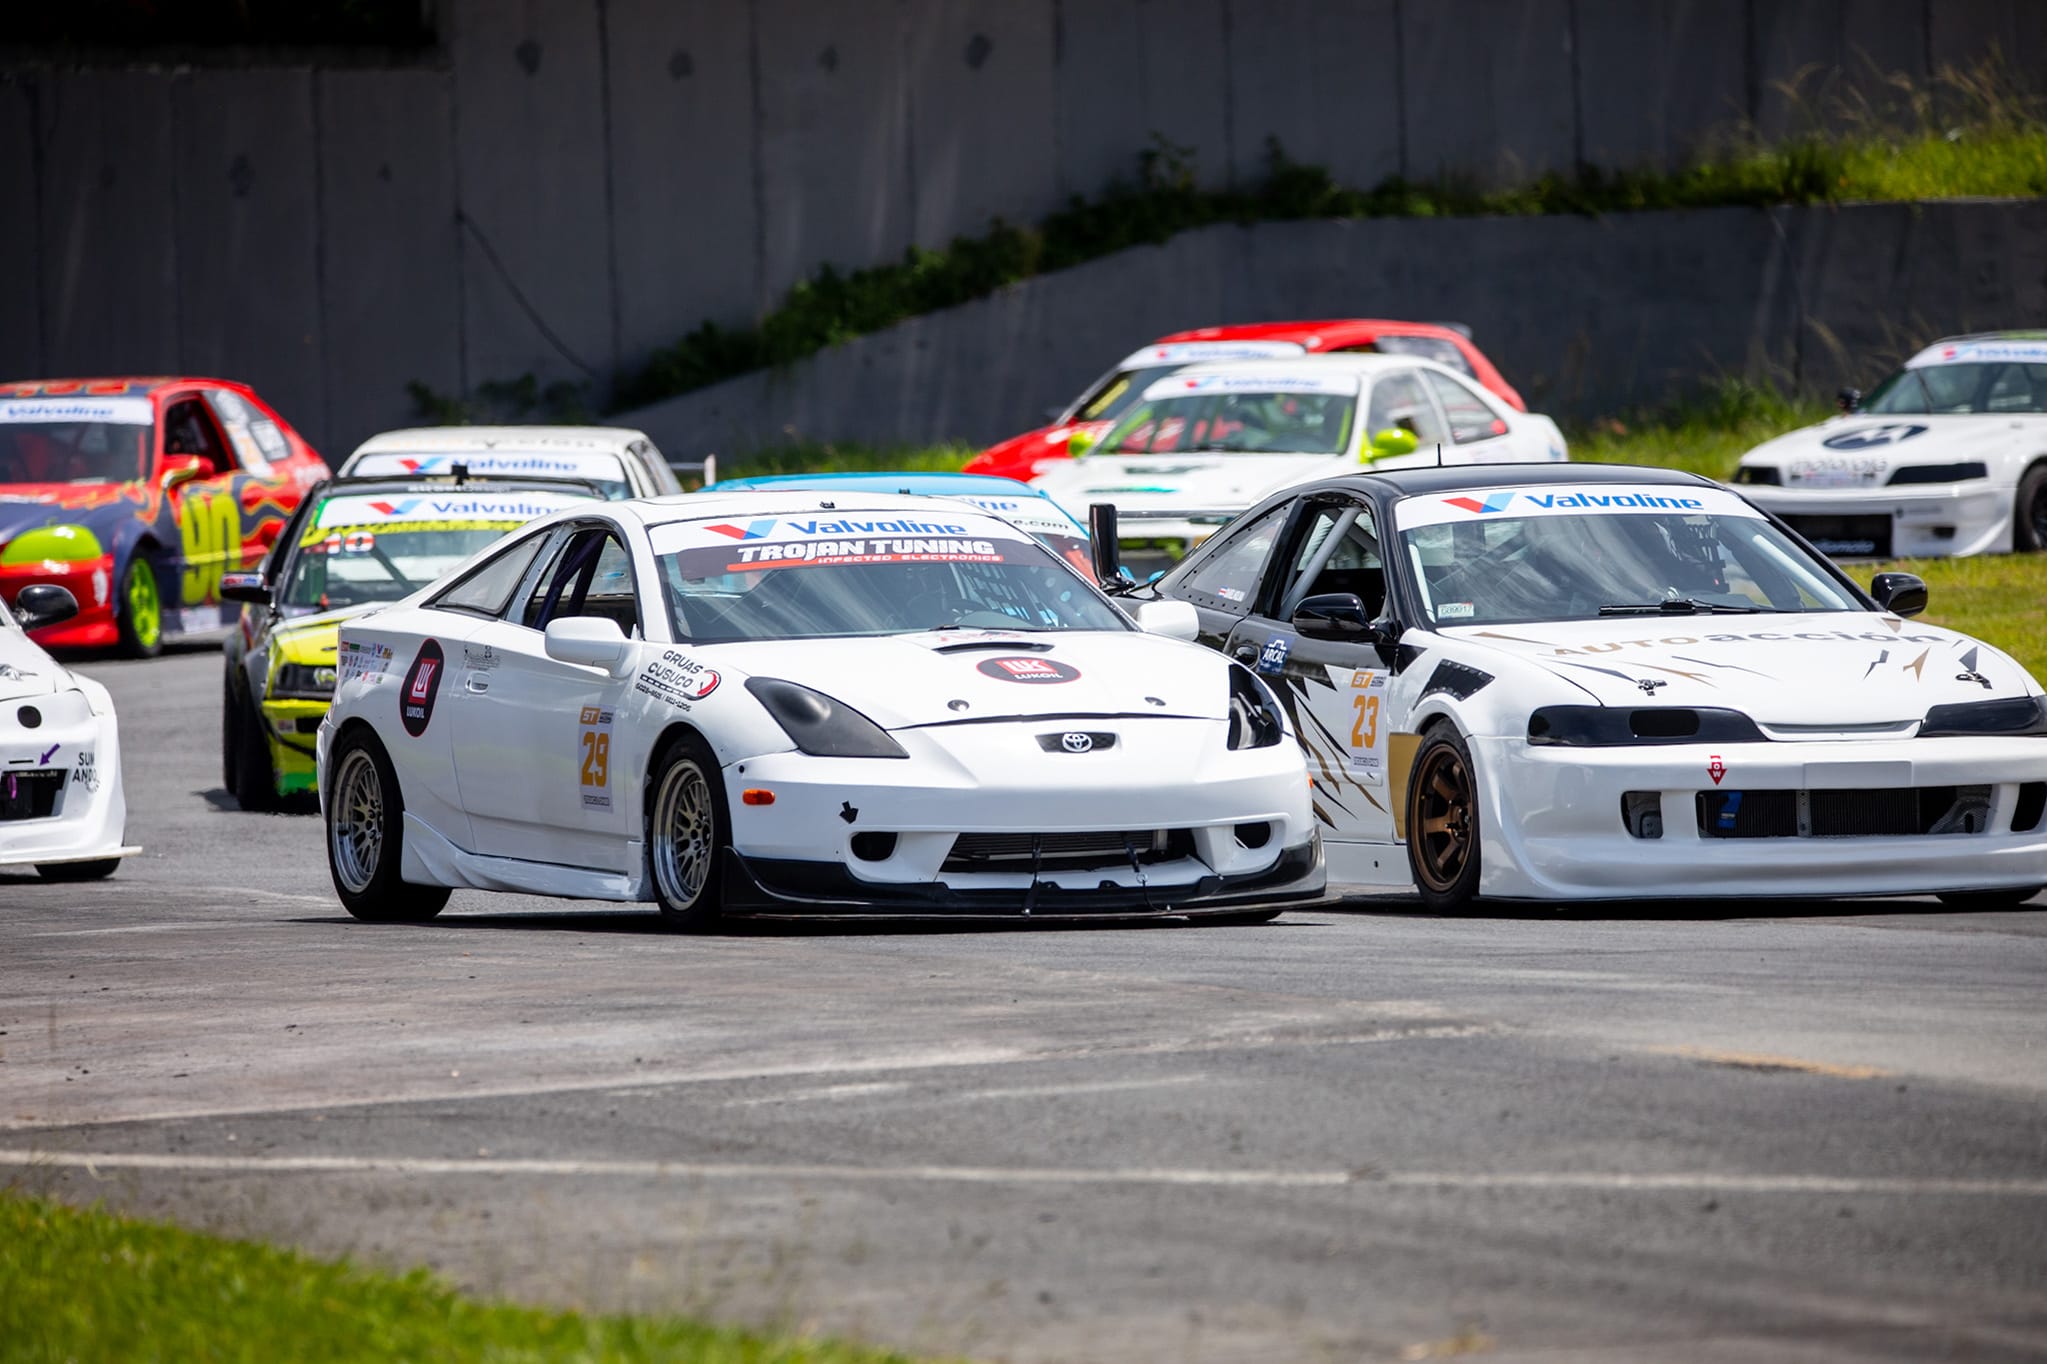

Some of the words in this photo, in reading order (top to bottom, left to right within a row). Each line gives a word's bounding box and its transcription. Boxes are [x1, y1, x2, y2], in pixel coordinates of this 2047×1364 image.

[1525, 492, 1703, 511] Valvoline
[787, 518, 968, 536] Valvoline
[737, 542, 864, 562] TROJAN
[869, 539, 996, 554] TUNING
[818, 555, 892, 564] INFECTED
[901, 554, 1002, 562] ELECTRONICS
[662, 650, 704, 674] GRUAS
[647, 662, 694, 688] CUSUCO
[1014, 672, 1064, 680] LUKOIL
[406, 705, 425, 719] LUKOIL
[1351, 694, 1379, 749] 23
[581, 731, 609, 787] 29
